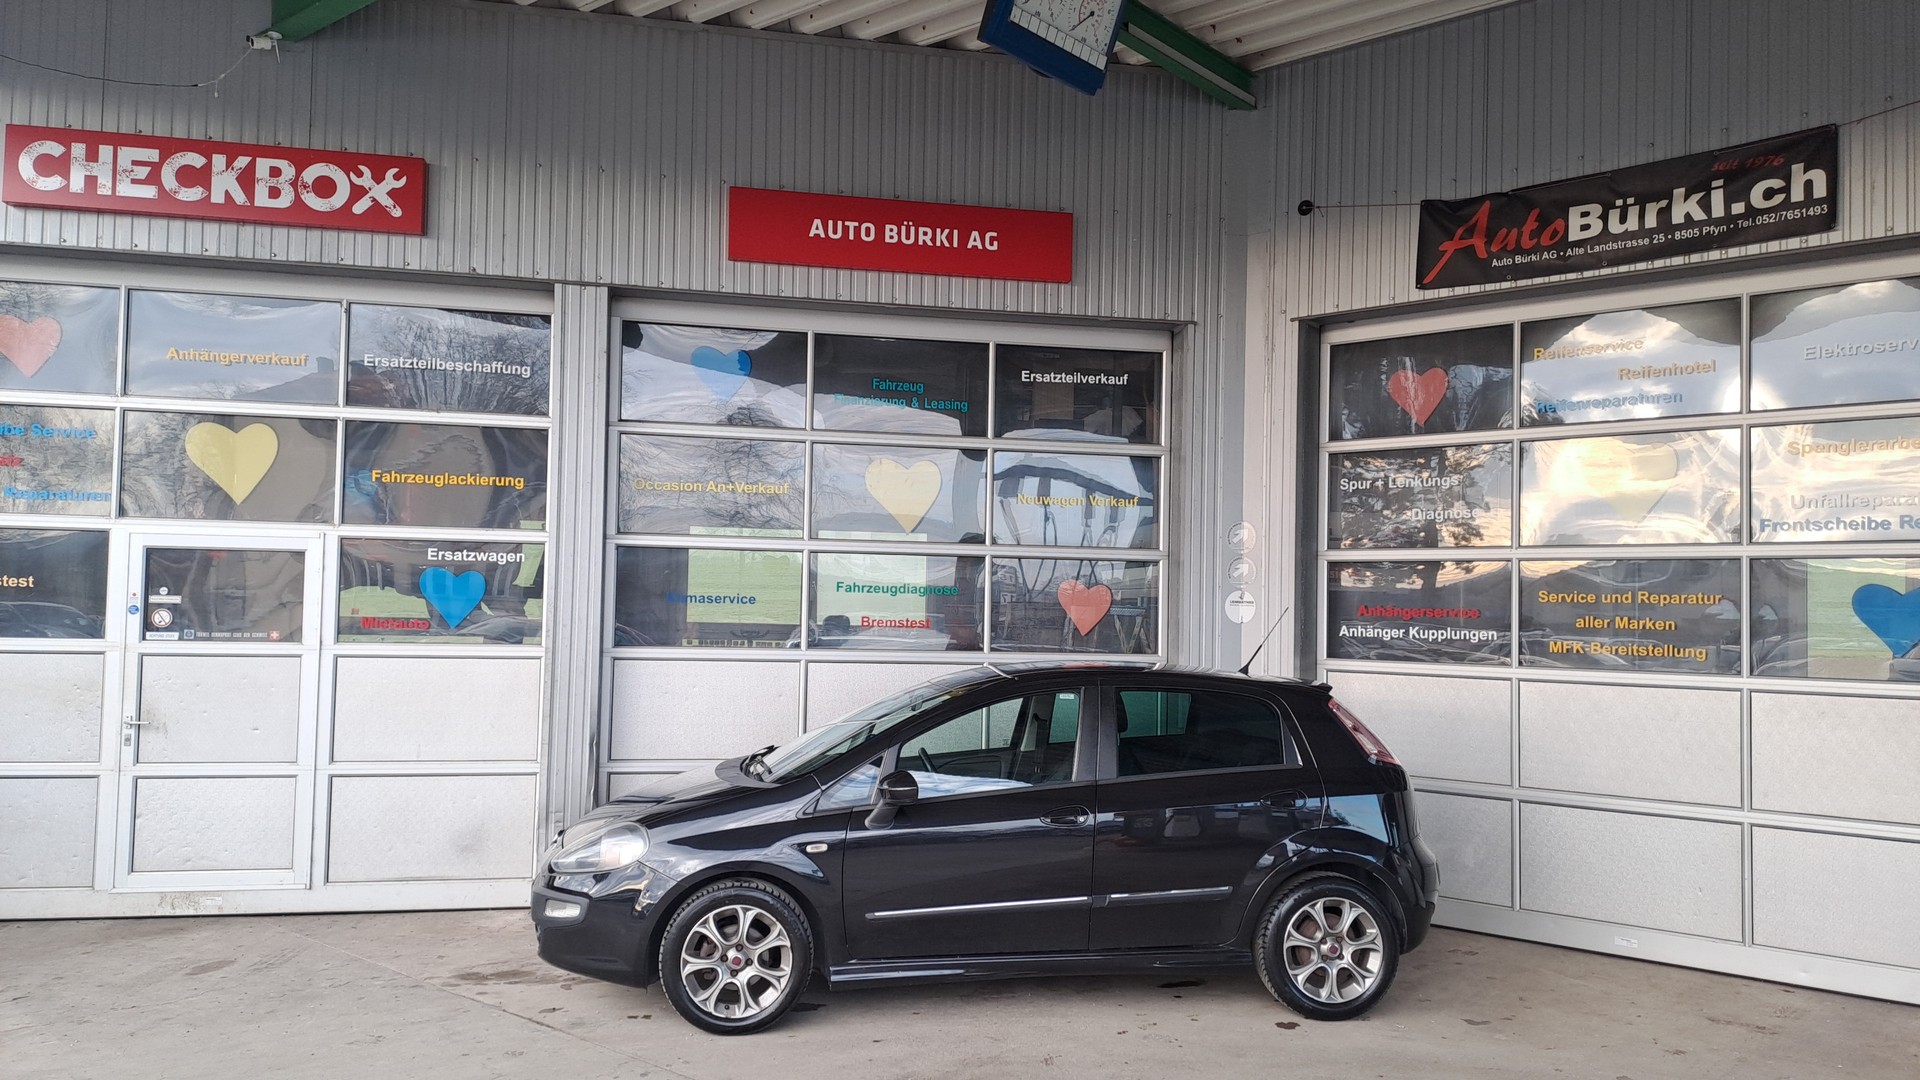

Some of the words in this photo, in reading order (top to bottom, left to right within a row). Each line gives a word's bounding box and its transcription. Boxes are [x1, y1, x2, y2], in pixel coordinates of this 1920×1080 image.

[1711, 159, 1739, 171] seit
[1745, 153, 1786, 168] 1976
[18, 140, 407, 217] CHECKBOX
[808, 219, 876, 243] AUTO
[884, 219, 958, 248] BÜRKI
[966, 230, 999, 251] AG
[1491, 257, 1513, 268] Auto
[1515, 249, 1539, 264] Bürki
[1542, 250, 1557, 260] AG
[1565, 245, 1585, 257] Alte
[1587, 237, 1649, 254] Landstrasse
[1652, 233, 1666, 244] 25
[1674, 228, 1700, 241] 8505
[1702, 224, 1727, 237] Pfyn
[166, 346, 309, 367] Anhängerverkauf
[1533, 338, 1644, 362] Reifenservice
[1804, 337, 1919, 361] Elektroserv
[363, 353, 532, 378] Ersatzteilbeschaffung
[1618, 359, 1716, 381] Reifenhotel
[872, 378, 924, 394] Fahrzeug
[1021, 370, 1129, 385] Ersatzteilverkauf
[834, 393, 907, 409] Finanzierung
[911, 397, 919, 408] &
[924, 398, 968, 412] Leasing
[1535, 391, 1683, 414] Reifenreparaturen
[31, 422, 97, 440] Service
[371, 469, 525, 490] Fahrzeuglackierung
[634, 478, 702, 491] Occasion
[1340, 478, 1372, 492] Spur
[1375, 478, 1384, 487] +
[1388, 474, 1460, 491] Lenkungs
[4, 485, 112, 503] Reparaturen
[1016, 493, 1085, 508] Neuwagen
[1088, 494, 1139, 508] Verkauf
[1411, 507, 1479, 522] Diagnose
[1759, 516, 1892, 533] Frontscheibe
[427, 547, 525, 564] Ersatzwagen
[0, 574, 34, 588] test
[836, 581, 958, 597] Fahrzeugdiagnose
[1537, 590, 1597, 604] Service
[1601, 590, 1633, 604] und
[1637, 591, 1722, 608] Reparatur
[1357, 604, 1481, 620] Anhängerservice
[861, 616, 931, 629] Bremstest
[1575, 616, 1610, 629] aller
[1615, 616, 1676, 631] Marken
[1339, 625, 1405, 640] Anhänger
[1409, 626, 1498, 643] Kupplungen
[1548, 641, 1708, 662] MFK-Bereitstellung
